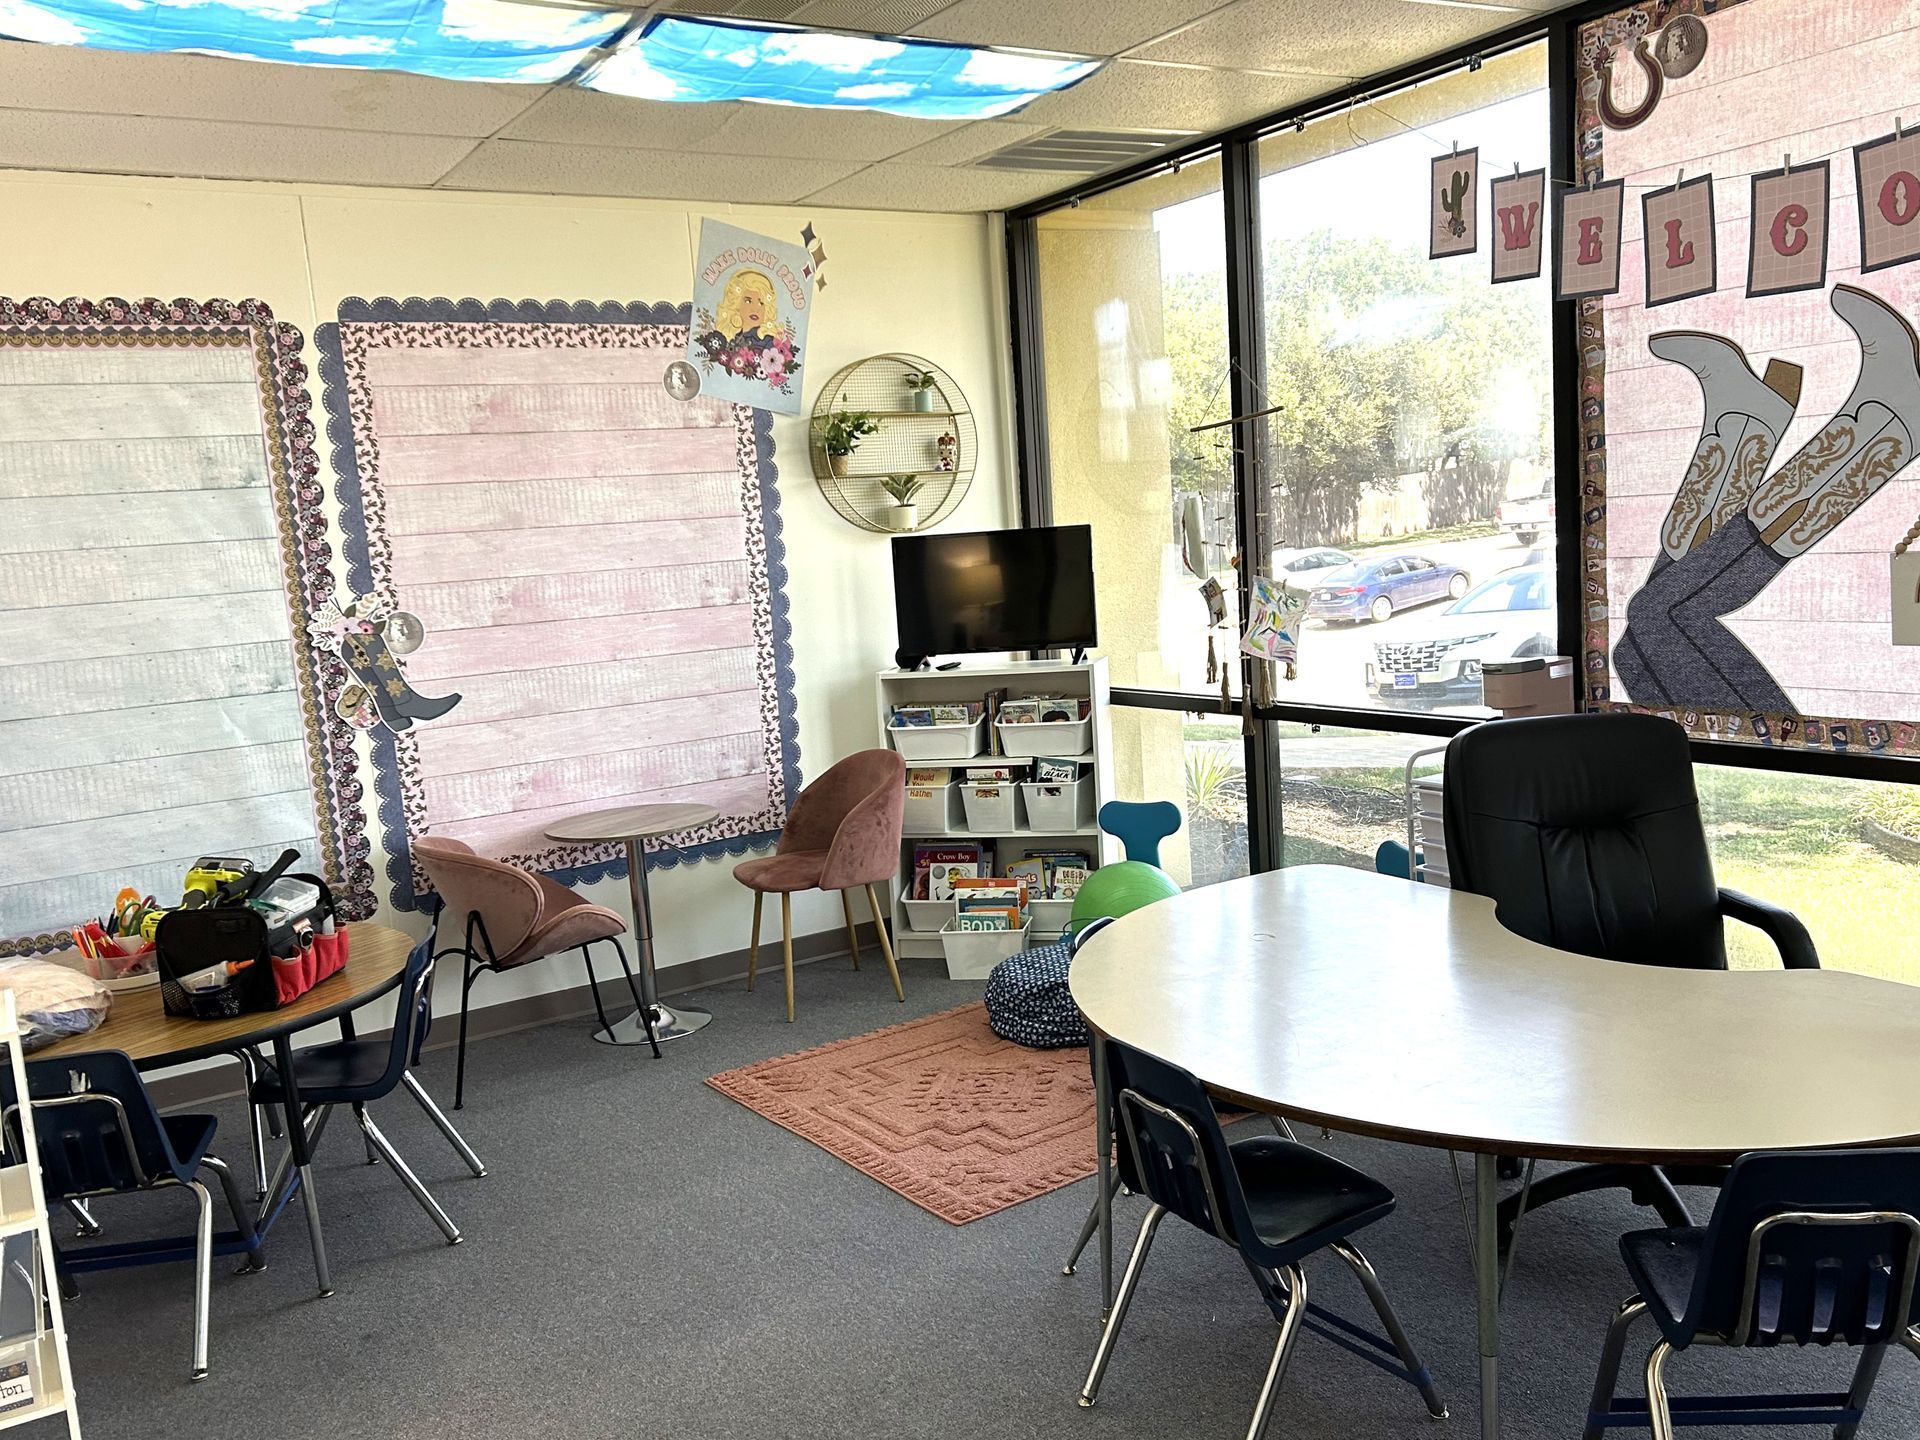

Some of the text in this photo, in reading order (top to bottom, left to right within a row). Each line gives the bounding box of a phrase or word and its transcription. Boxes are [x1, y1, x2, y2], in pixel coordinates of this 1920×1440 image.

[702, 247, 806, 310] MAKE DOLLY PROUD
[913, 773, 935, 782] Would
[1044, 770, 1070, 779] BLACK
[957, 853, 971, 862] Boy
